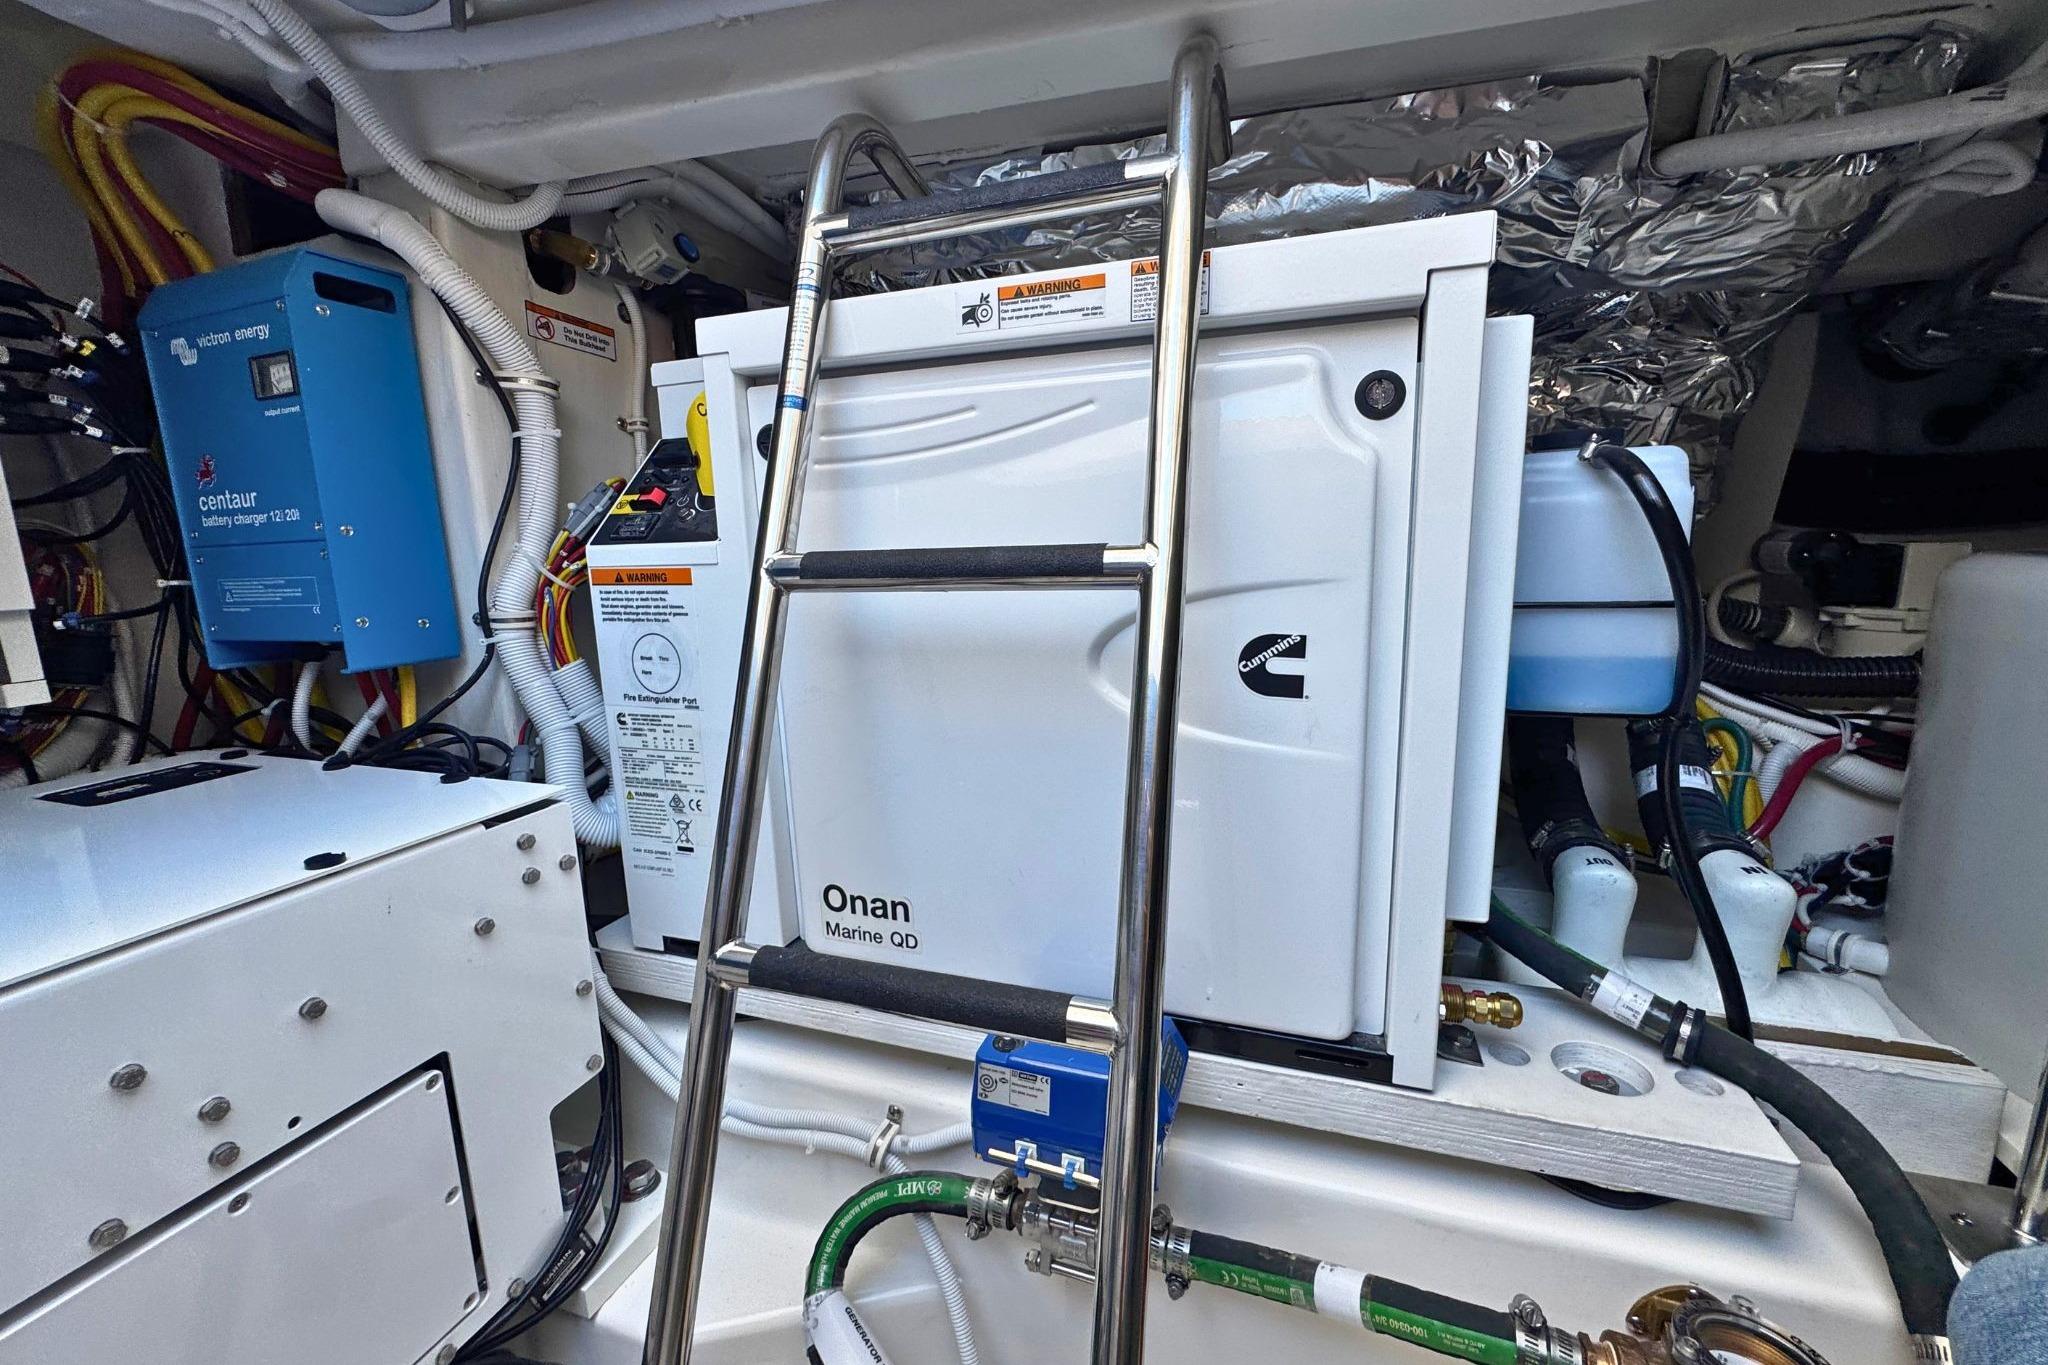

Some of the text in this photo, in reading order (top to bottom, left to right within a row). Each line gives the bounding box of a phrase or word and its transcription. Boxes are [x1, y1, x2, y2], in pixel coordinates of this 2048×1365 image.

[1027, 278, 1080, 295] WARNING
[197, 324, 270, 348] victron energy
[563, 326, 572, 334] Do
[574, 330, 584, 338] Not
[585, 333, 597, 342] Drill
[564, 334, 606, 352] This Bulkhead
[200, 490, 257, 511] centaur
[202, 515, 232, 528] battery
[234, 512, 268, 526] charger
[626, 572, 668, 583] WARNING
[1239, 634, 1302, 672] Cummins
[624, 694, 697, 705] Fire Extinguisher Port
[1585, 858, 1614, 866] OUT
[1740, 866, 1768, 875] IN
[823, 884, 910, 922] Onan
[826, 921, 918, 949] Marine QD
[826, 1189, 888, 1254] PREMIUM MARINE WATER
[845, 1306, 882, 1364] GENERATOR
[1389, 1319, 1428, 1338] 100-0340
